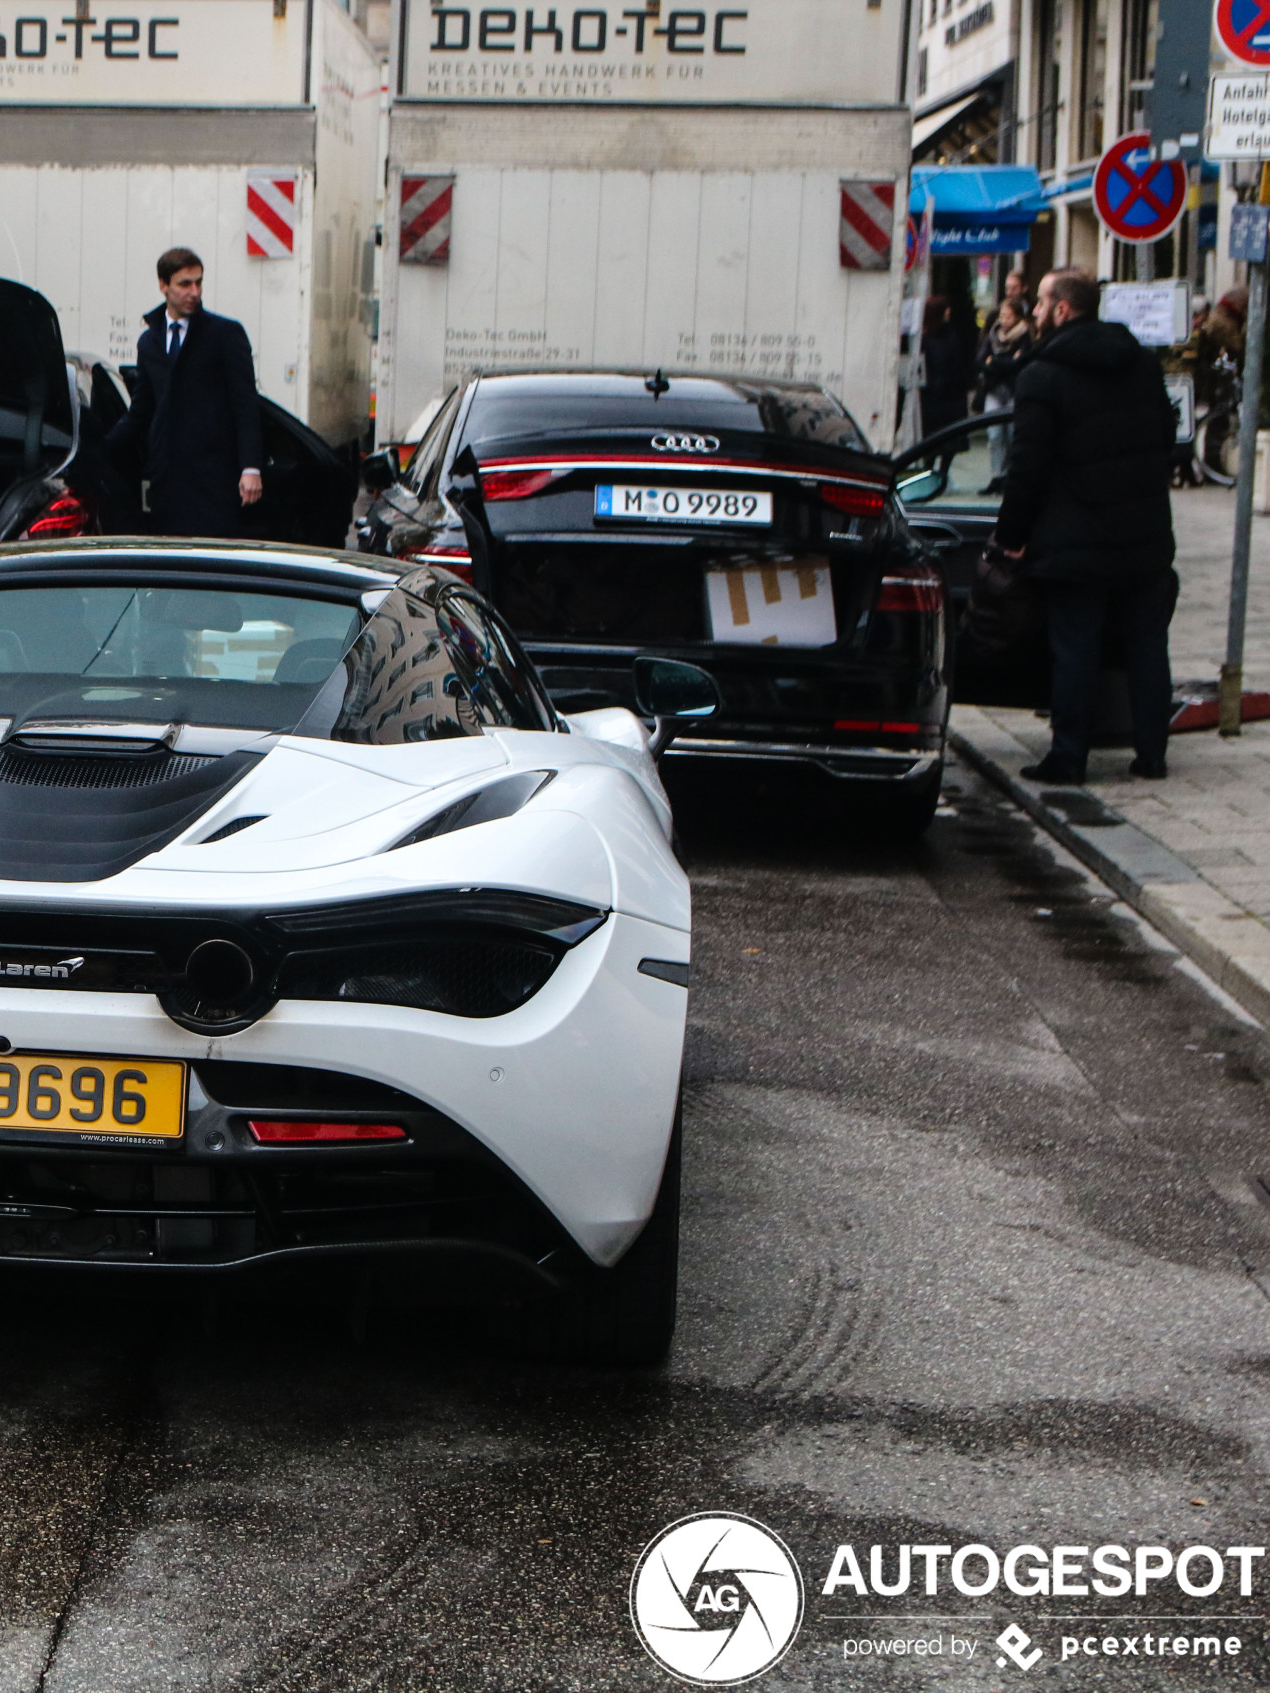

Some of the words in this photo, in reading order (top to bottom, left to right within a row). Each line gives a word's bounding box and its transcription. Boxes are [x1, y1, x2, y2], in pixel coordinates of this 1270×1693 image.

[428, 62, 534, 77] KREATIVES
[546, 63, 655, 79] HANDWERK
[666, 64, 705, 79] FÜR
[427, 81, 505, 94] MESSEN
[516, 83, 527, 95] &
[539, 83, 613, 96] EVENTS
[1222, 107, 1270, 126] Hotelg
[624, 490, 642, 513] M
[687, 492, 758, 518] 9989
[80, 1133, 165, 1146] www.procarlease.com
